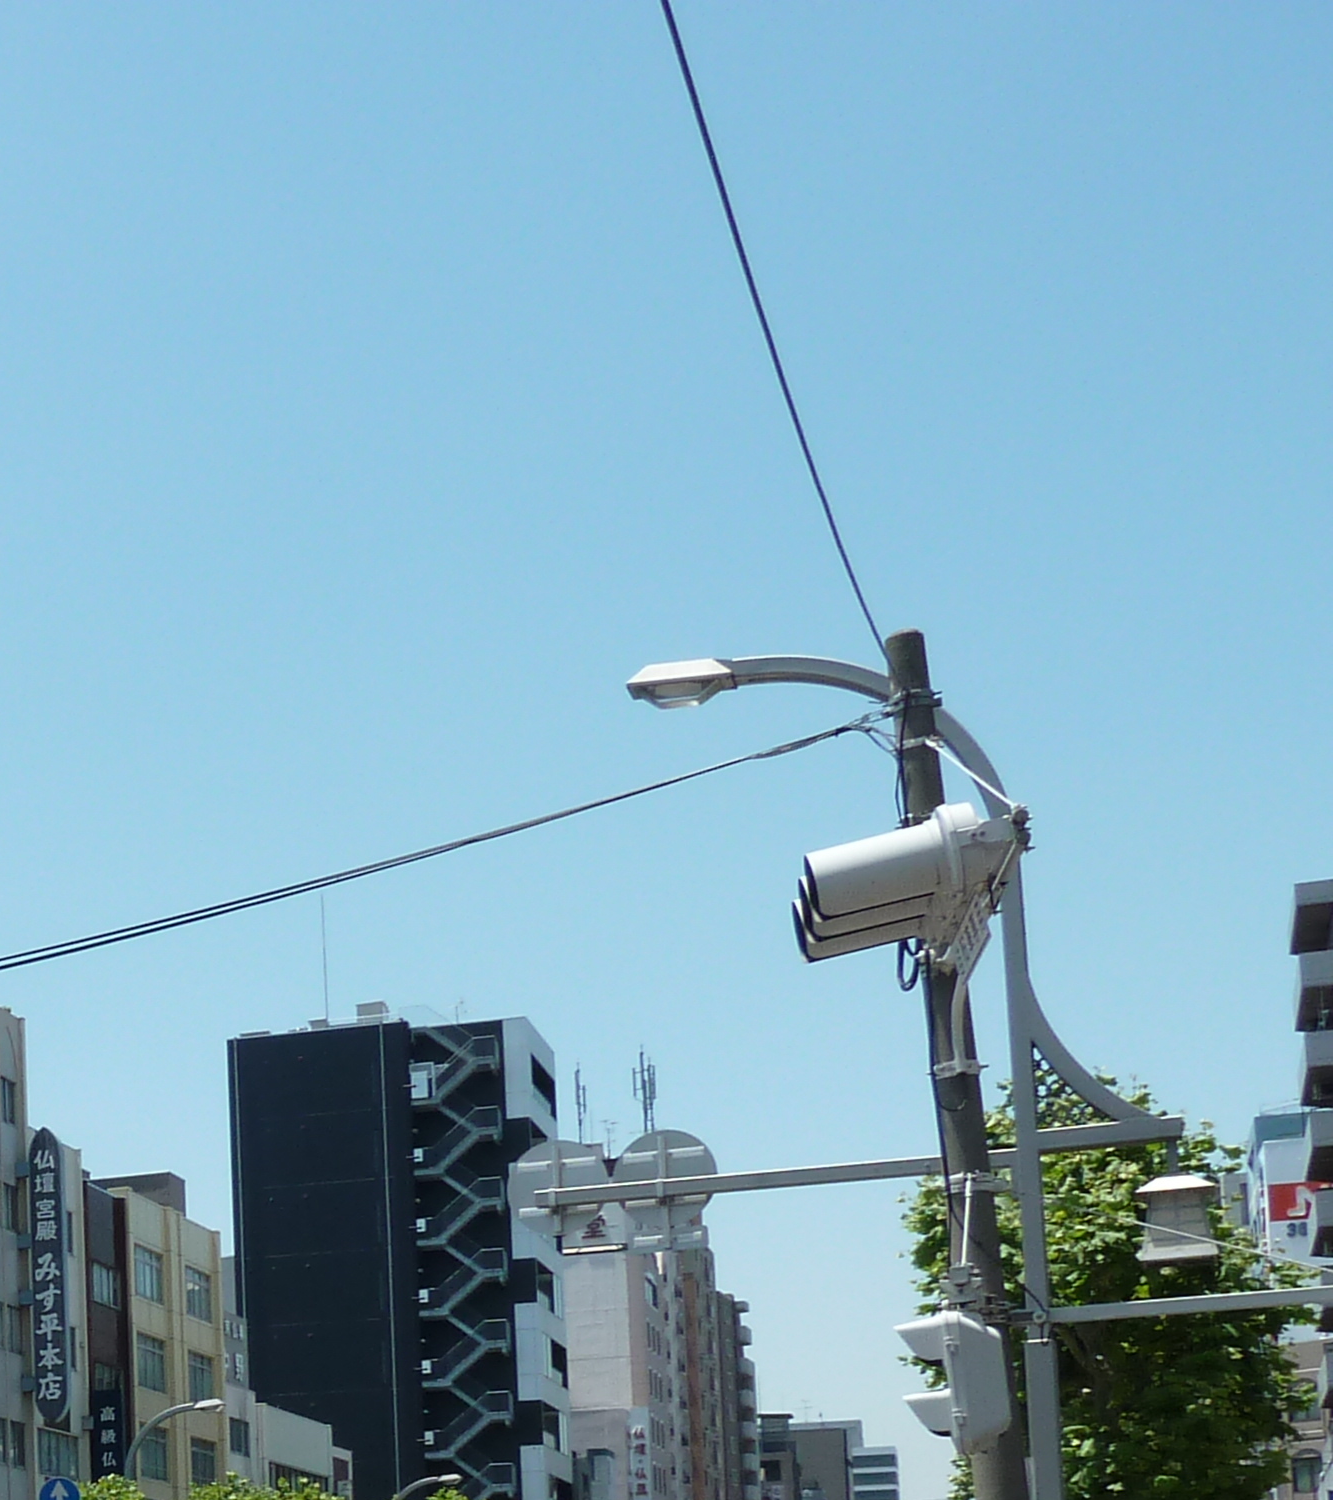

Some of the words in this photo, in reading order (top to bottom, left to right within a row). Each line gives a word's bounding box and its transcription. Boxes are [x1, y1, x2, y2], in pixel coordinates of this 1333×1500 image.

[33, 1150, 58, 1241] 仏壇宮殿
[35, 1252, 64, 1402] みす平本店
